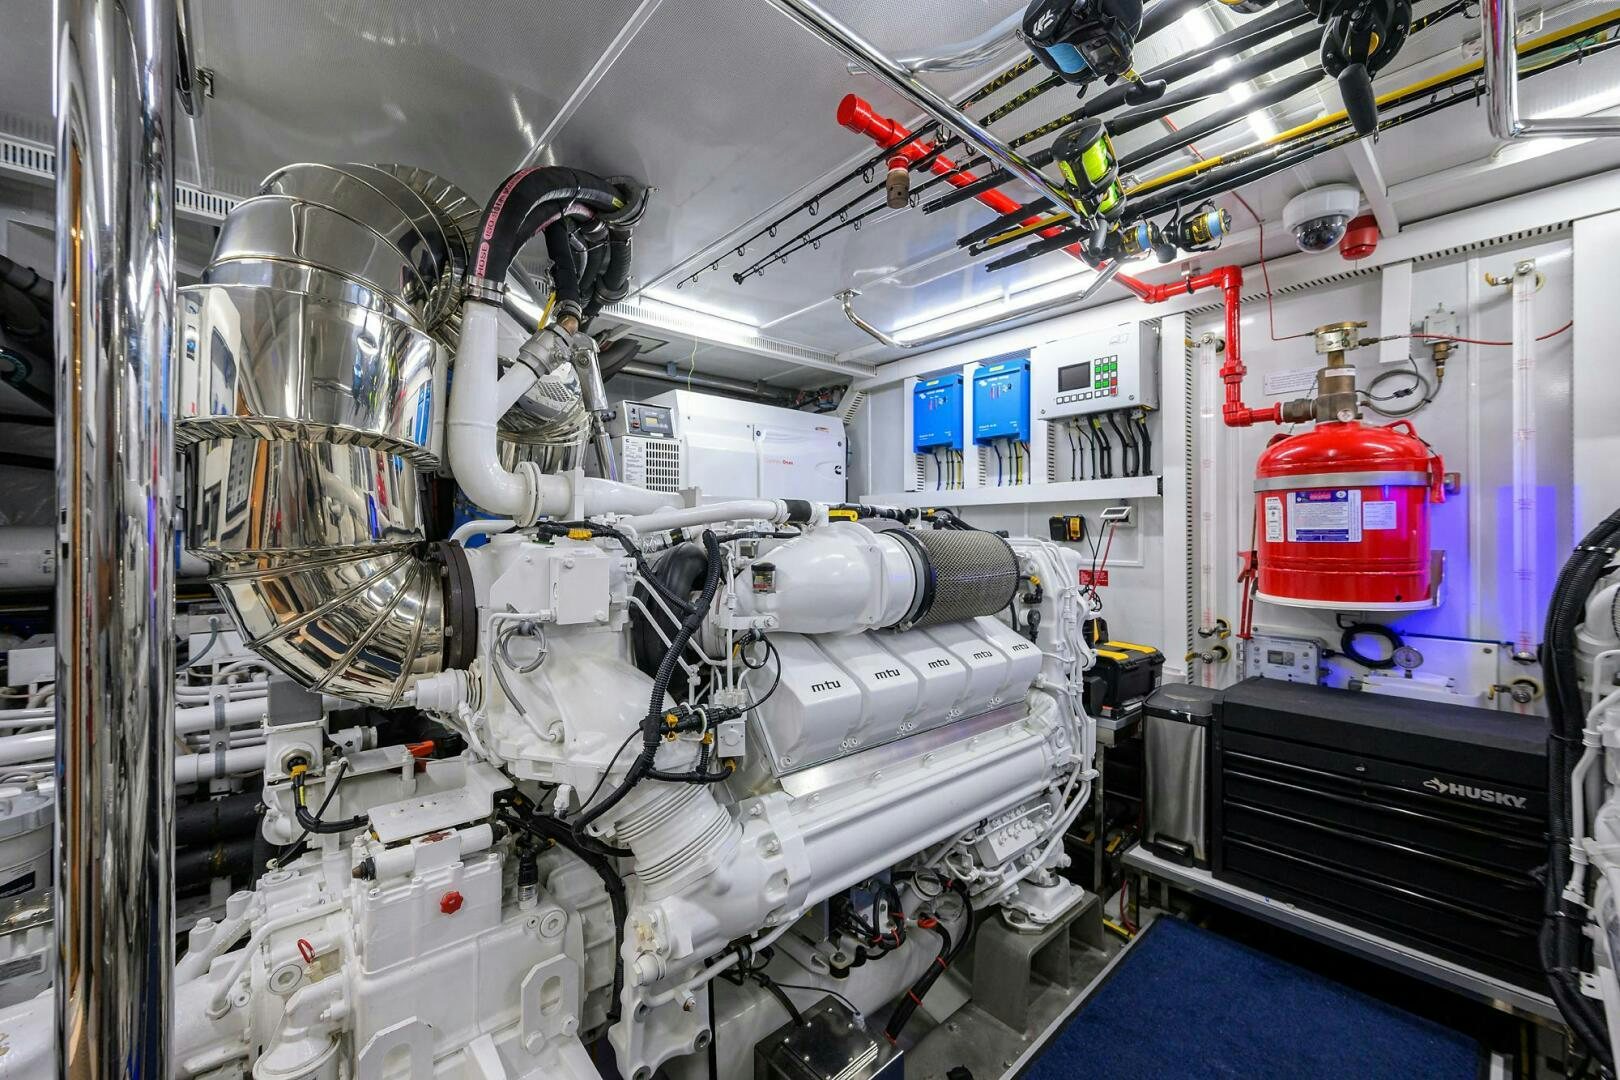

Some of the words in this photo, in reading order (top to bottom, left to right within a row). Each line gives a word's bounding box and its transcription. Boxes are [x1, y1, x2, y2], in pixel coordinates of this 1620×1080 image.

[1012, 643, 1029, 652] mtu
[973, 650, 993, 660] mtu
[928, 658, 950, 669] mtu
[875, 668, 900, 680] mtu
[811, 679, 841, 693] mtu
[1449, 783, 1527, 809] HUSKY
